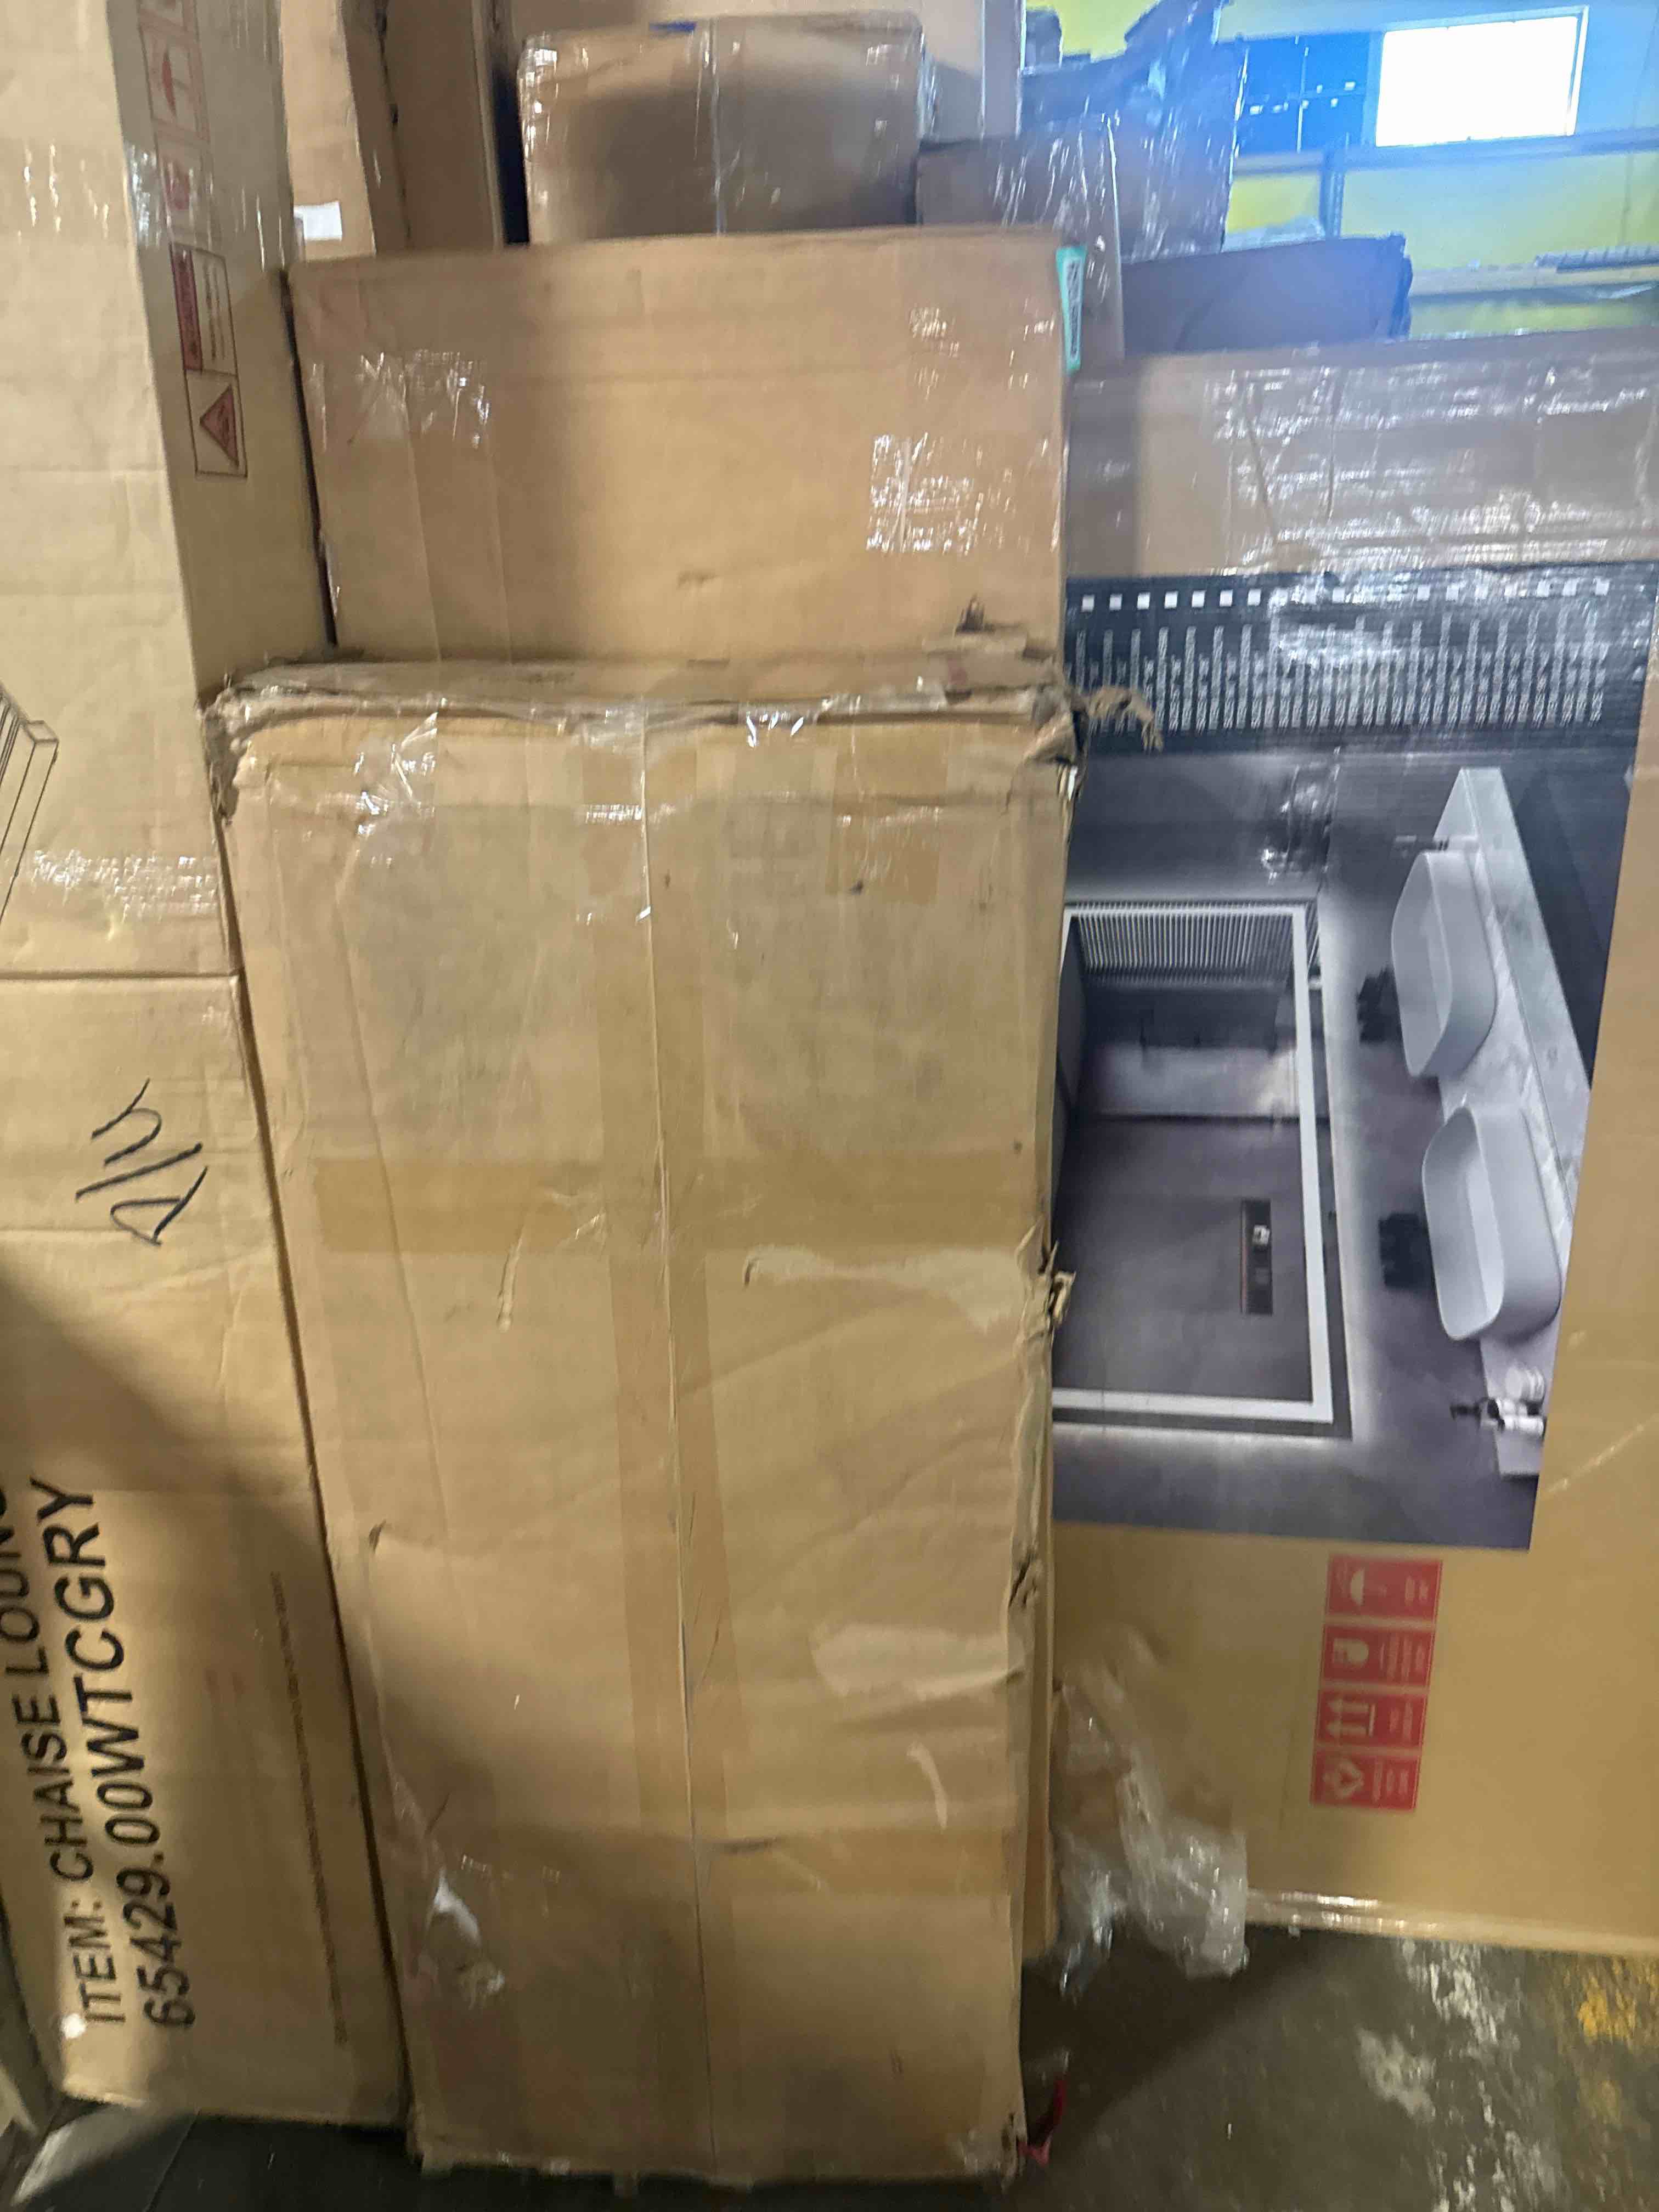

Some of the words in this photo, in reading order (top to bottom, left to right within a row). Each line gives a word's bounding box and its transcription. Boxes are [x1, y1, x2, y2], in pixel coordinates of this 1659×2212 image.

[0, 1487, 48, 1676] LOU
[12, 1694, 94, 1882] CHAISE
[29, 1476, 195, 2029] 65429.00WTCGRY
[64, 1900, 125, 2023] ITEM:
